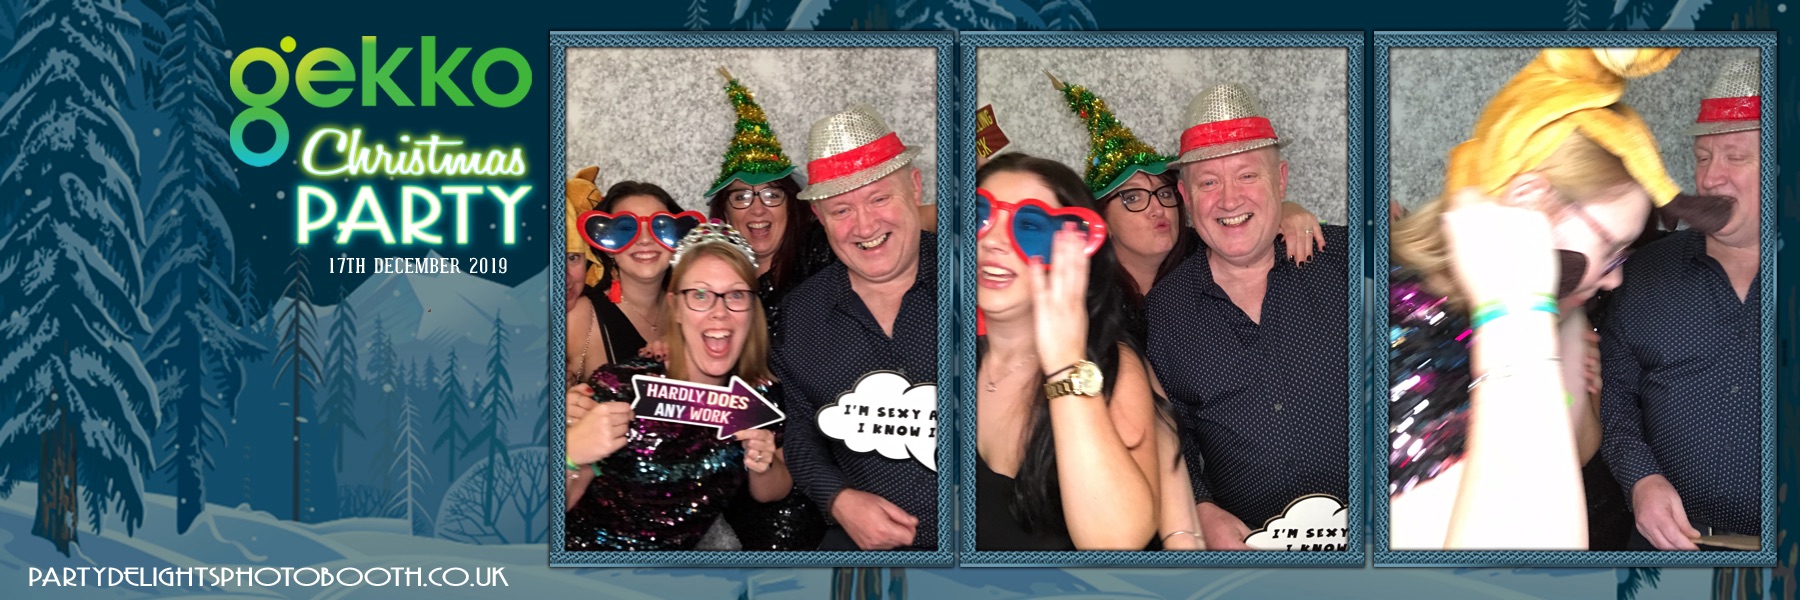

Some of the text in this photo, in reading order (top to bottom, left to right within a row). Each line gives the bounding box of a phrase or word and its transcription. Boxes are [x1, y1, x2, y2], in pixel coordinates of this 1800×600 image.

[646, 383, 750, 410] HARDLY DOES
[653, 402, 733, 425] ANY WORK
[844, 404, 870, 416] I'M
[877, 406, 922, 420] SEXY
[857, 422, 865, 434] I
[872, 423, 921, 437] KNOW
[1272, 527, 1348, 539] I'M SEXY
[1300, 543, 1347, 551] KNOW
